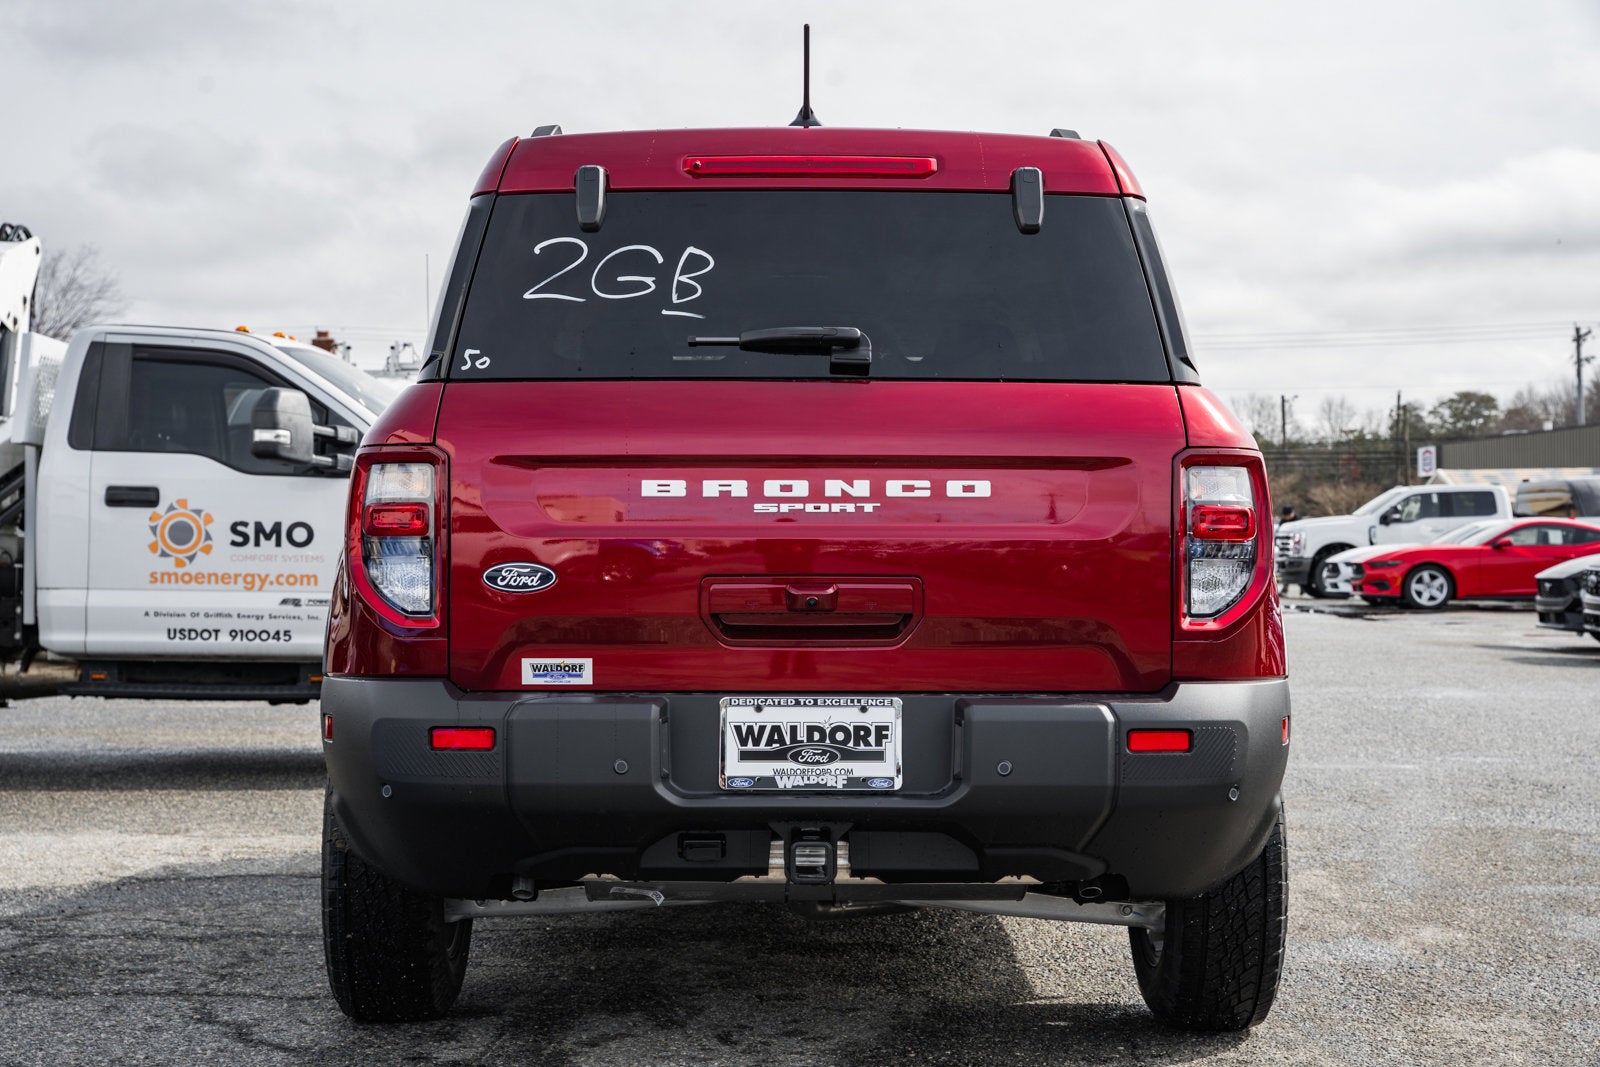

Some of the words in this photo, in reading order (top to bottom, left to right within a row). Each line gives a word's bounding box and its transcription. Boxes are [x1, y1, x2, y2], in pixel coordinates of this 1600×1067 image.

[522, 236, 715, 304] 2GB
[460, 348, 491, 371] 50
[641, 479, 992, 498] BRONCO
[753, 502, 881, 513] SPORT
[229, 520, 315, 548] SMO
[230, 553, 278, 563] COMFORT
[281, 554, 325, 564] SYSTEMS
[149, 570, 319, 591] smoenergy.com
[497, 567, 542, 586] Ford
[143, 610, 150, 618] A
[154, 610, 186, 619] Division
[190, 611, 200, 619] Of
[203, 612, 233, 620] Griffith
[237, 612, 265, 622] Energy
[167, 627, 221, 642] USDOT
[229, 630, 292, 643] 910045
[530, 662, 585, 673] WALDORF
[731, 698, 794, 706] DEDICATED
[799, 698, 813, 706] TO
[817, 698, 892, 706] EXCELLENCE
[733, 723, 891, 748] WALDORF
[798, 749, 830, 763] Ford
[772, 768, 854, 776] WALDORFFORDCOM
[774, 774, 848, 789] WALDORF
